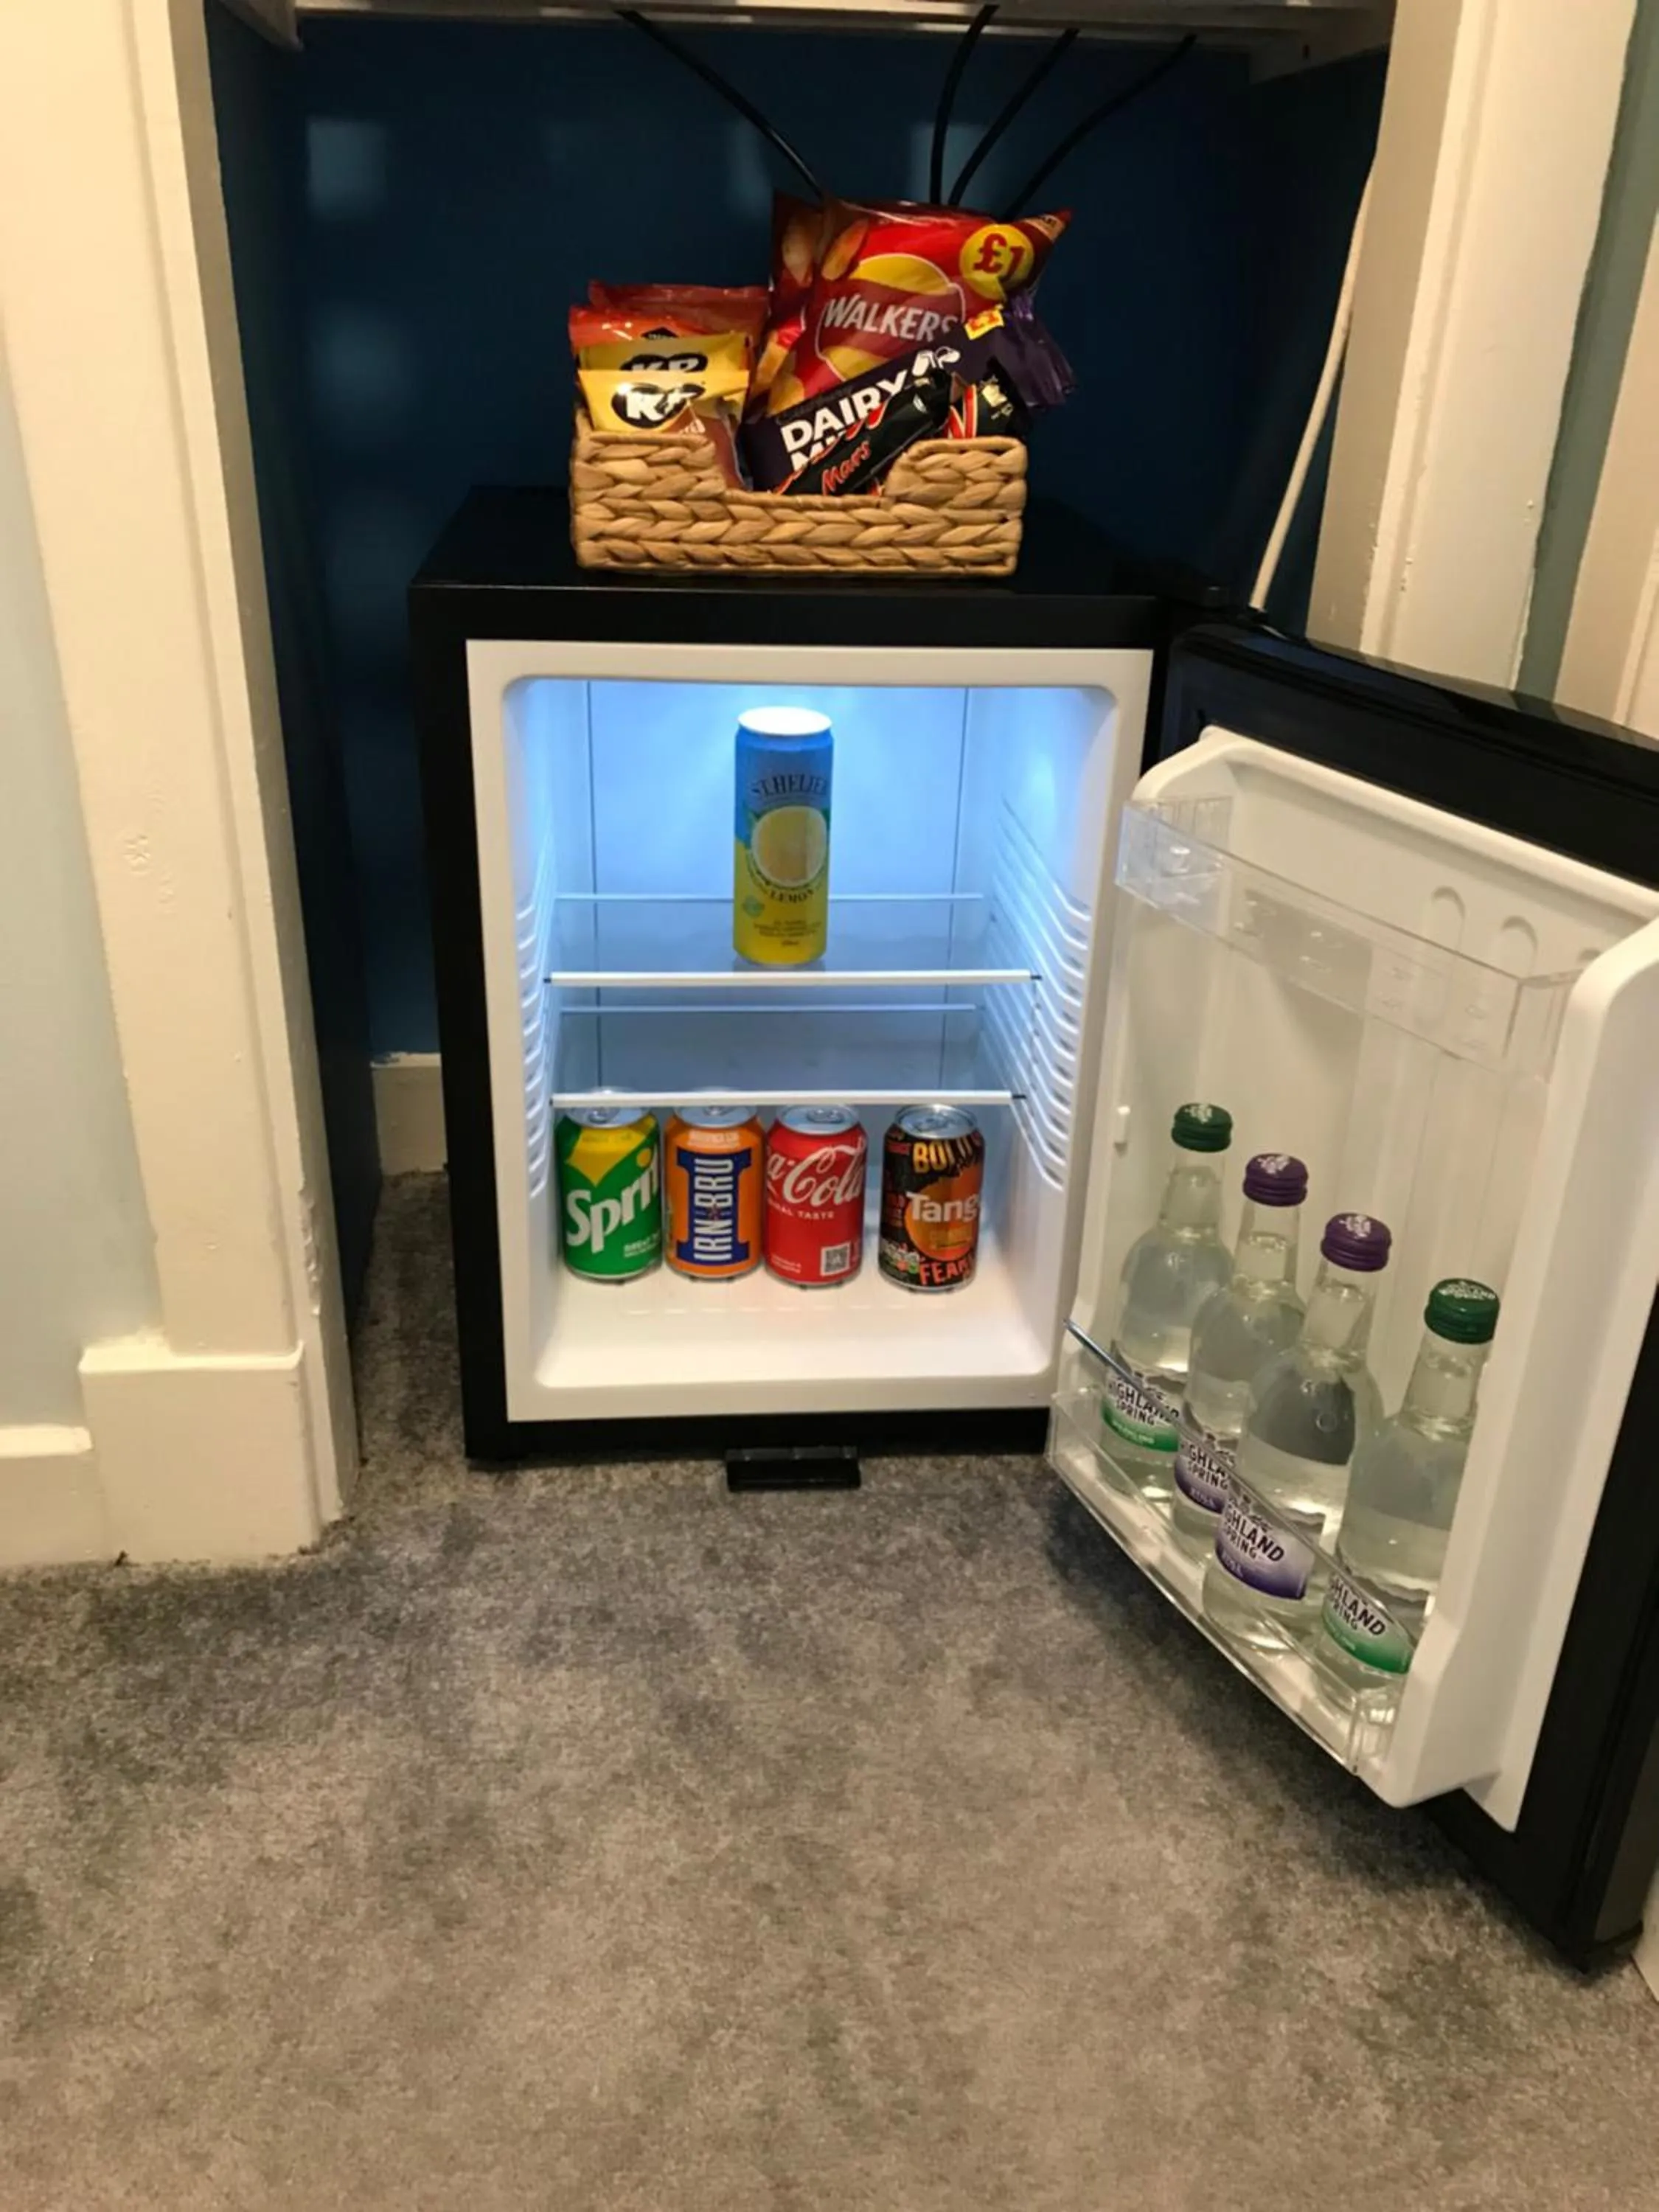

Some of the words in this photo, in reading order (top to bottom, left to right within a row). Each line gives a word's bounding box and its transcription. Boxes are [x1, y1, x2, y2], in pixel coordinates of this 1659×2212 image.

[973, 233, 1025, 283] £1
[780, 369, 908, 452] DAIRY
[796, 1210, 835, 1220] TASTE
